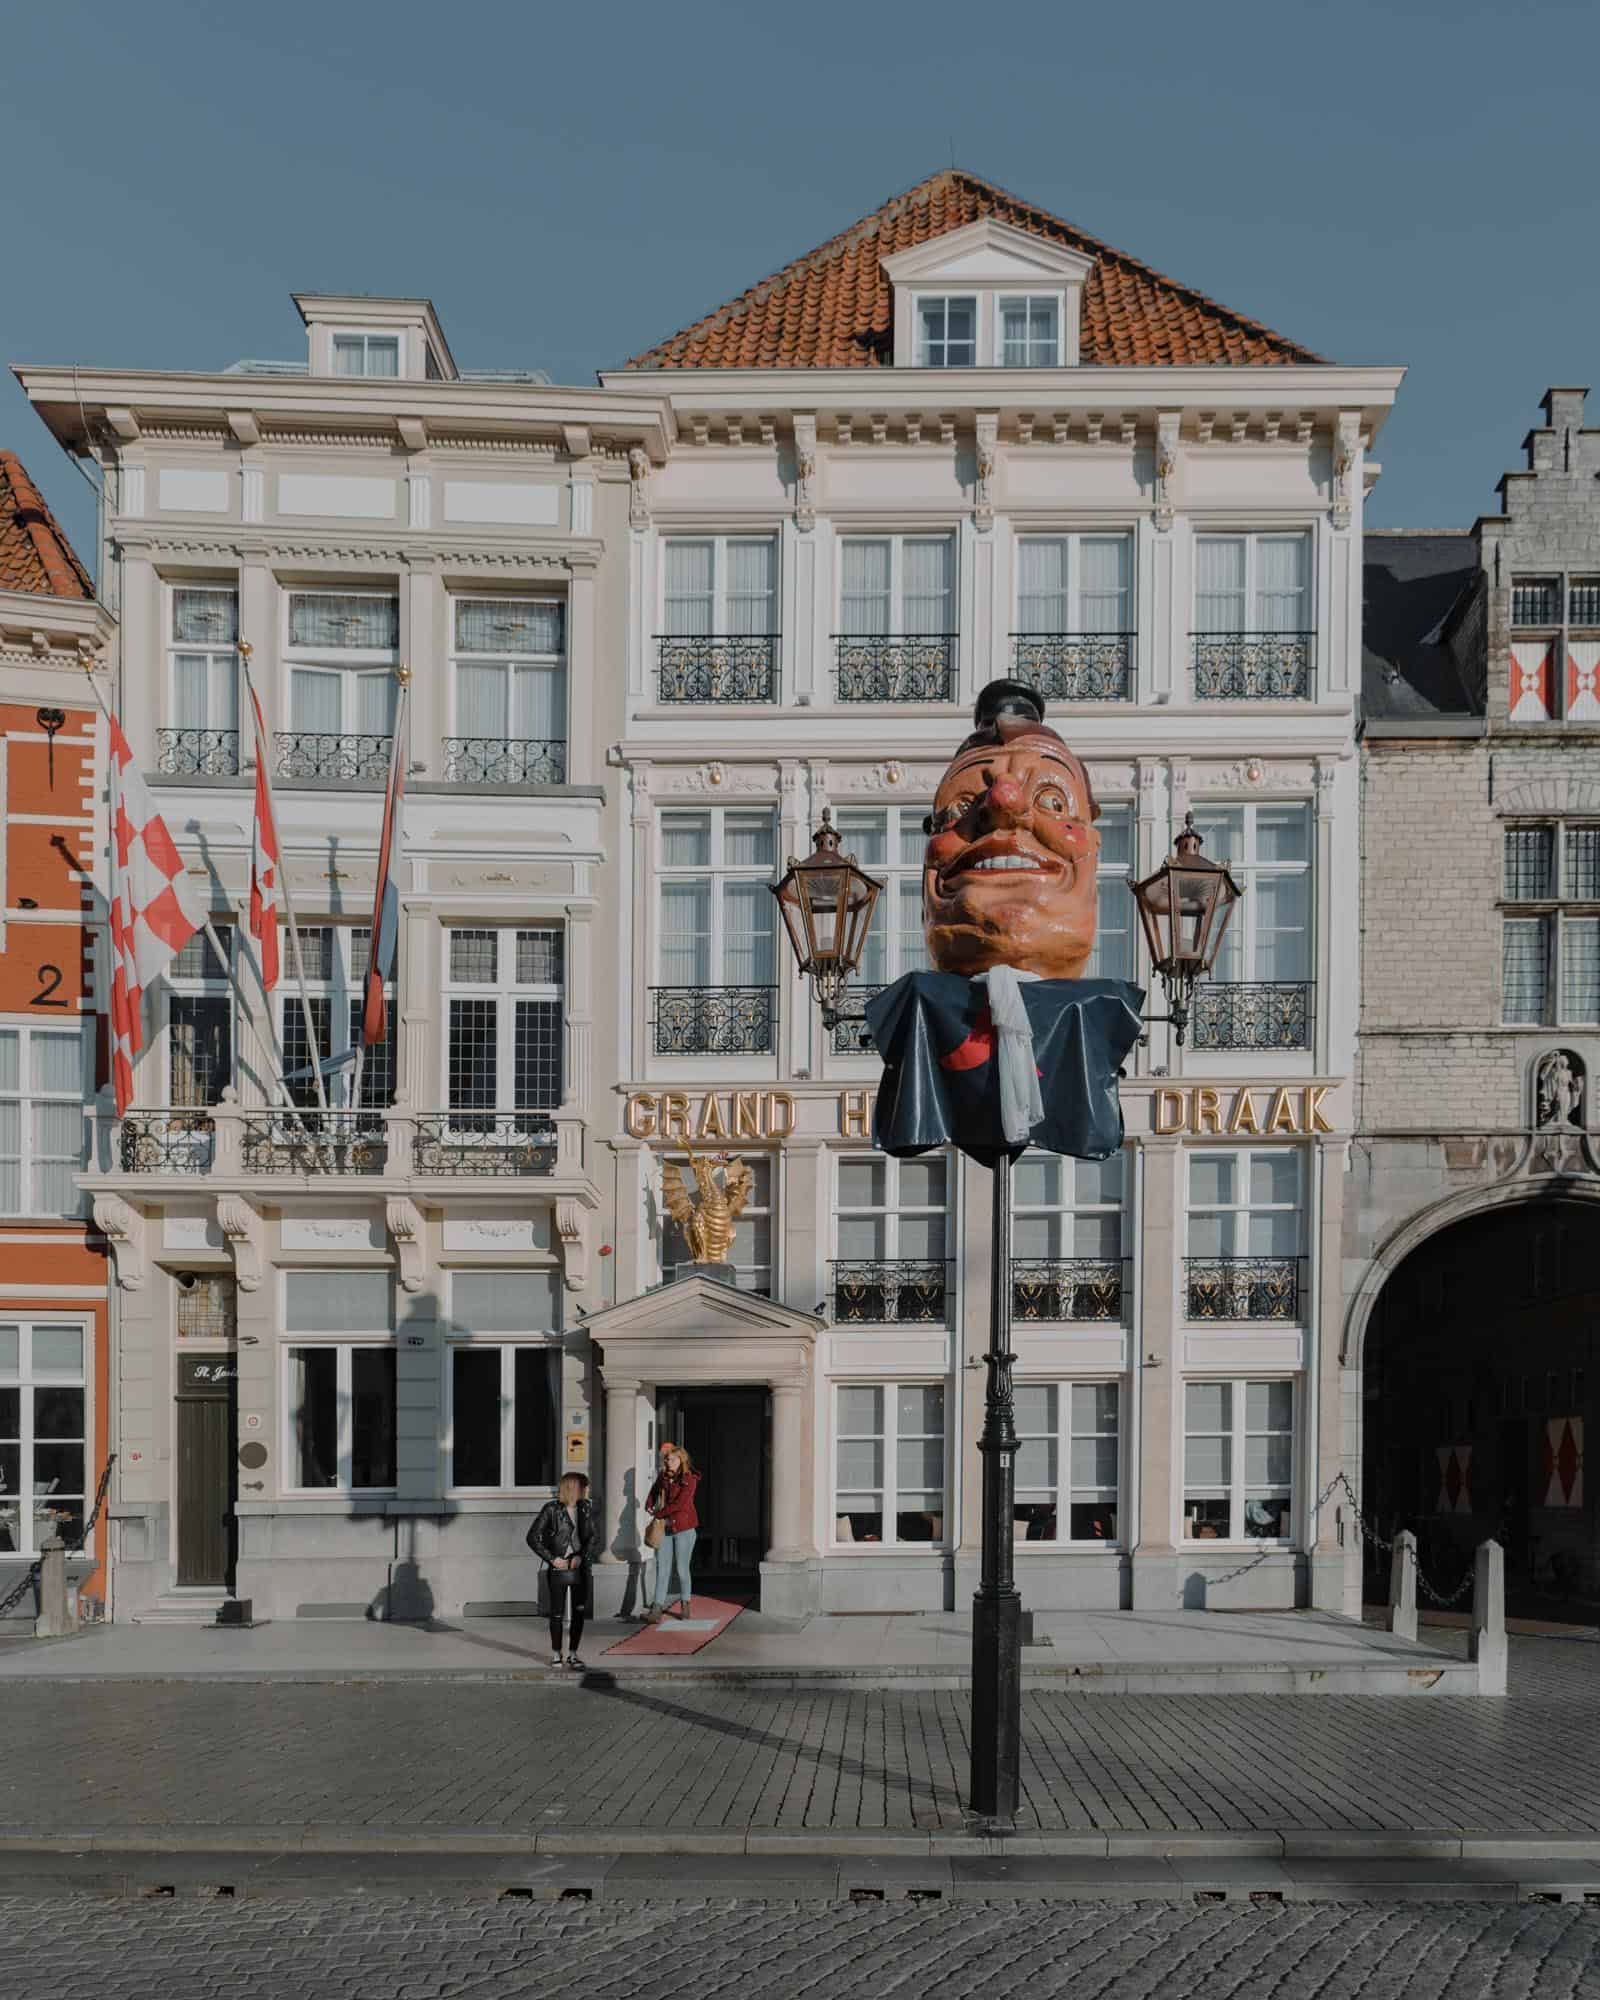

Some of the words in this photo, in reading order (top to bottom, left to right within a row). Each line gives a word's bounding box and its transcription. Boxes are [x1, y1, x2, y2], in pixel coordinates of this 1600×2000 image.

[29, 964, 68, 1007] 2
[627, 1091, 796, 1139] GRAND
[1154, 1086, 1333, 1135] DRAAK
